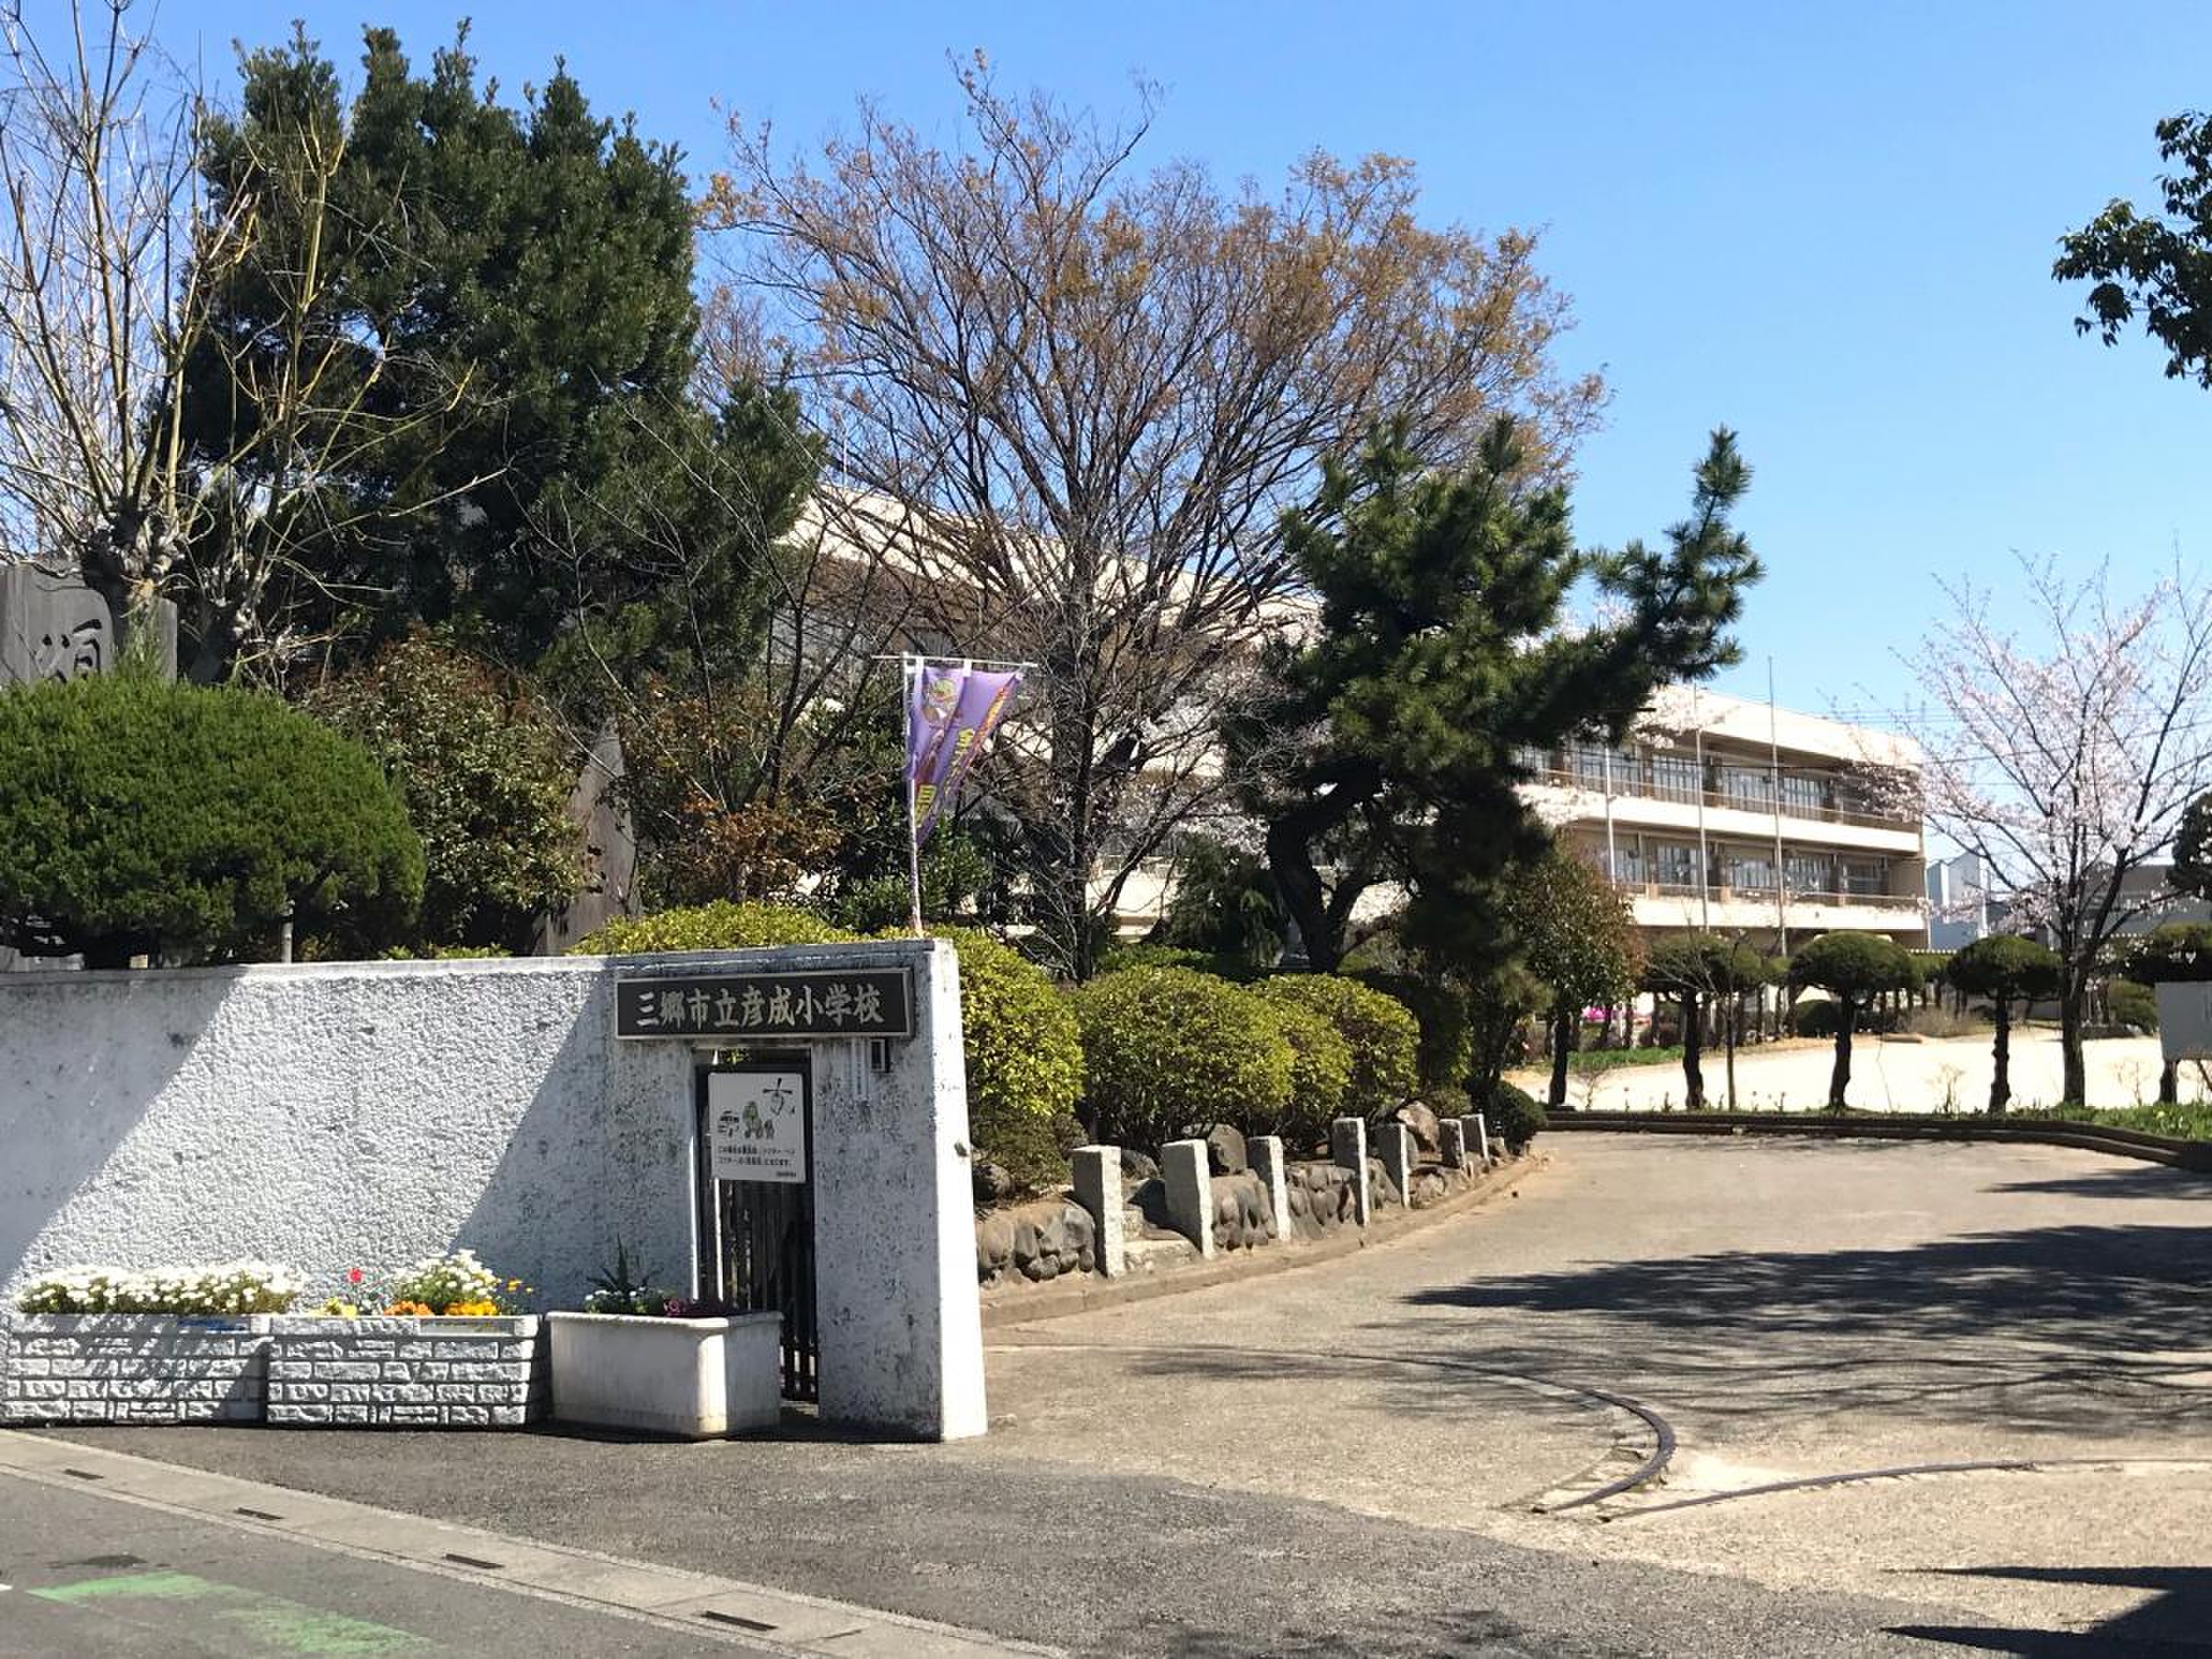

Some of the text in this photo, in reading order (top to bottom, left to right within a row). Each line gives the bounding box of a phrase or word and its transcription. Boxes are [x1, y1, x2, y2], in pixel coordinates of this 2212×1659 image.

[636, 982, 885, 1030] 三郷市立彦成小学校
